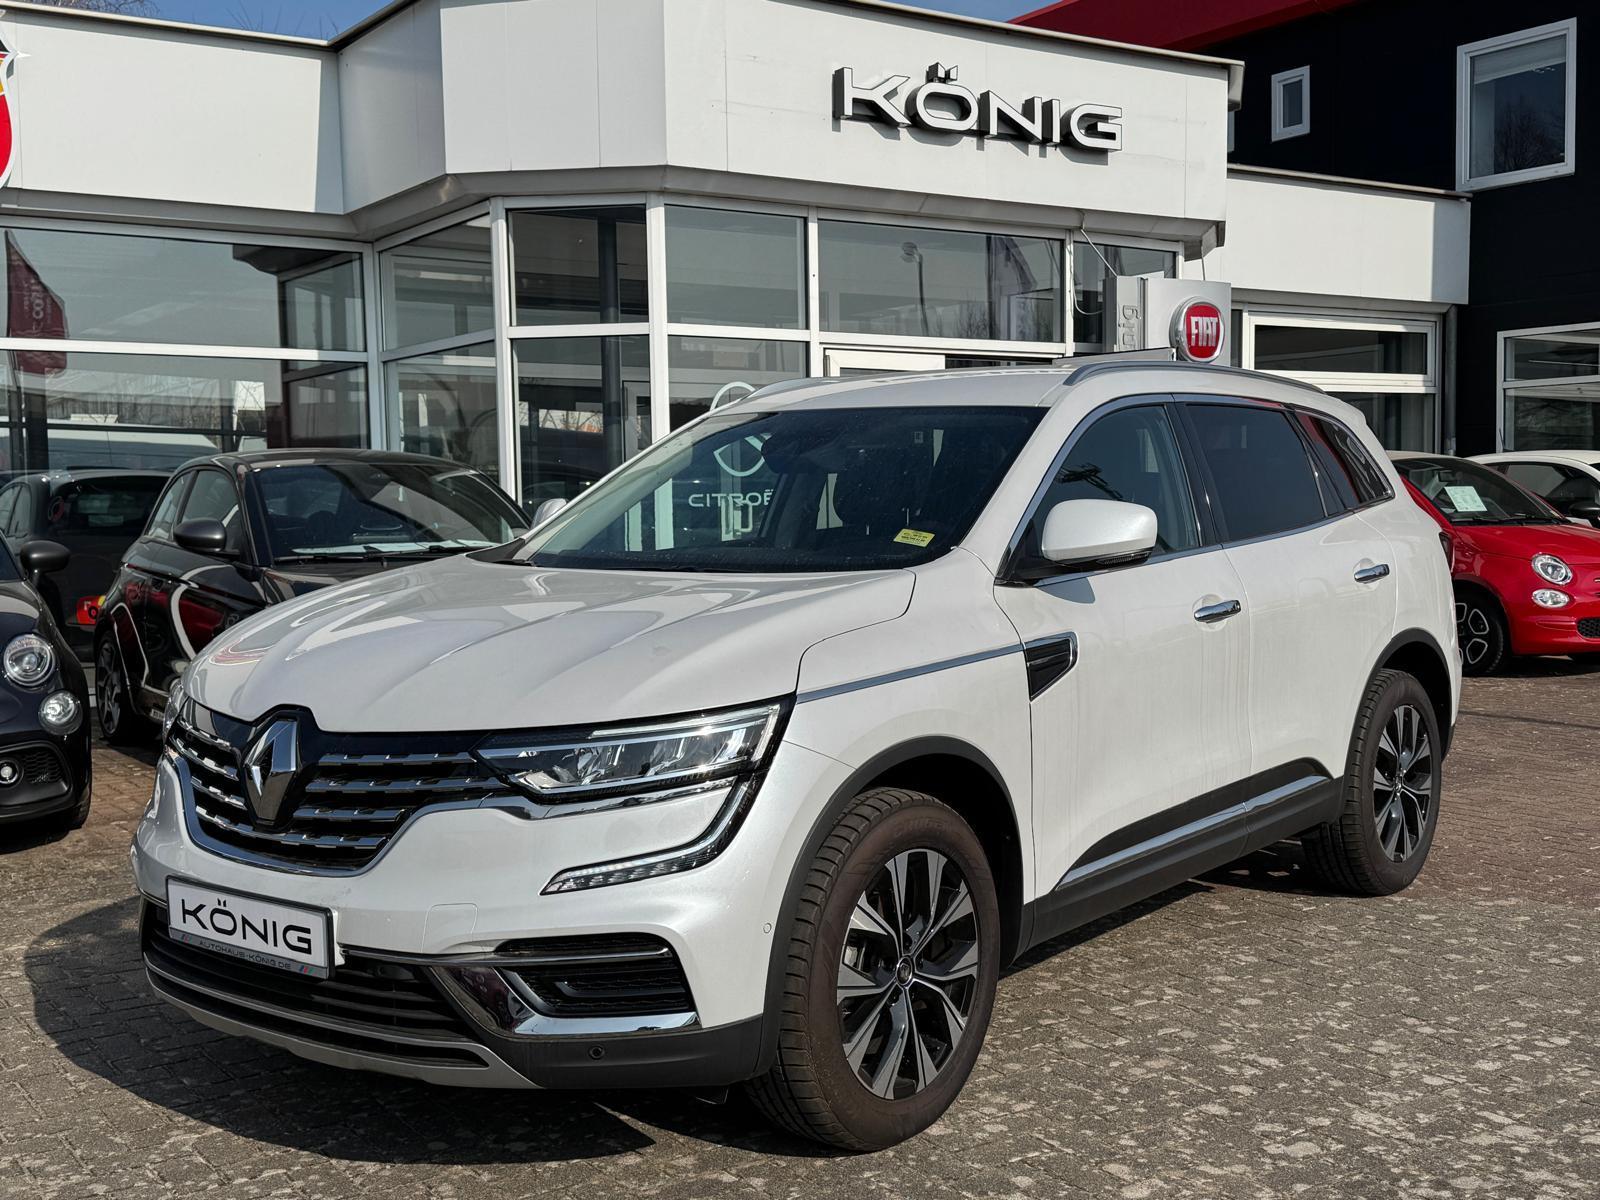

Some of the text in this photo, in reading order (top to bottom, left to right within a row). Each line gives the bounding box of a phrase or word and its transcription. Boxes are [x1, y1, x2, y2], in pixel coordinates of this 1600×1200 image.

[832, 62, 1122, 152] KÖNIG
[1190, 316, 1219, 347] FIAT
[688, 489, 774, 508] CITROË
[181, 898, 313, 955] KÖNIG
